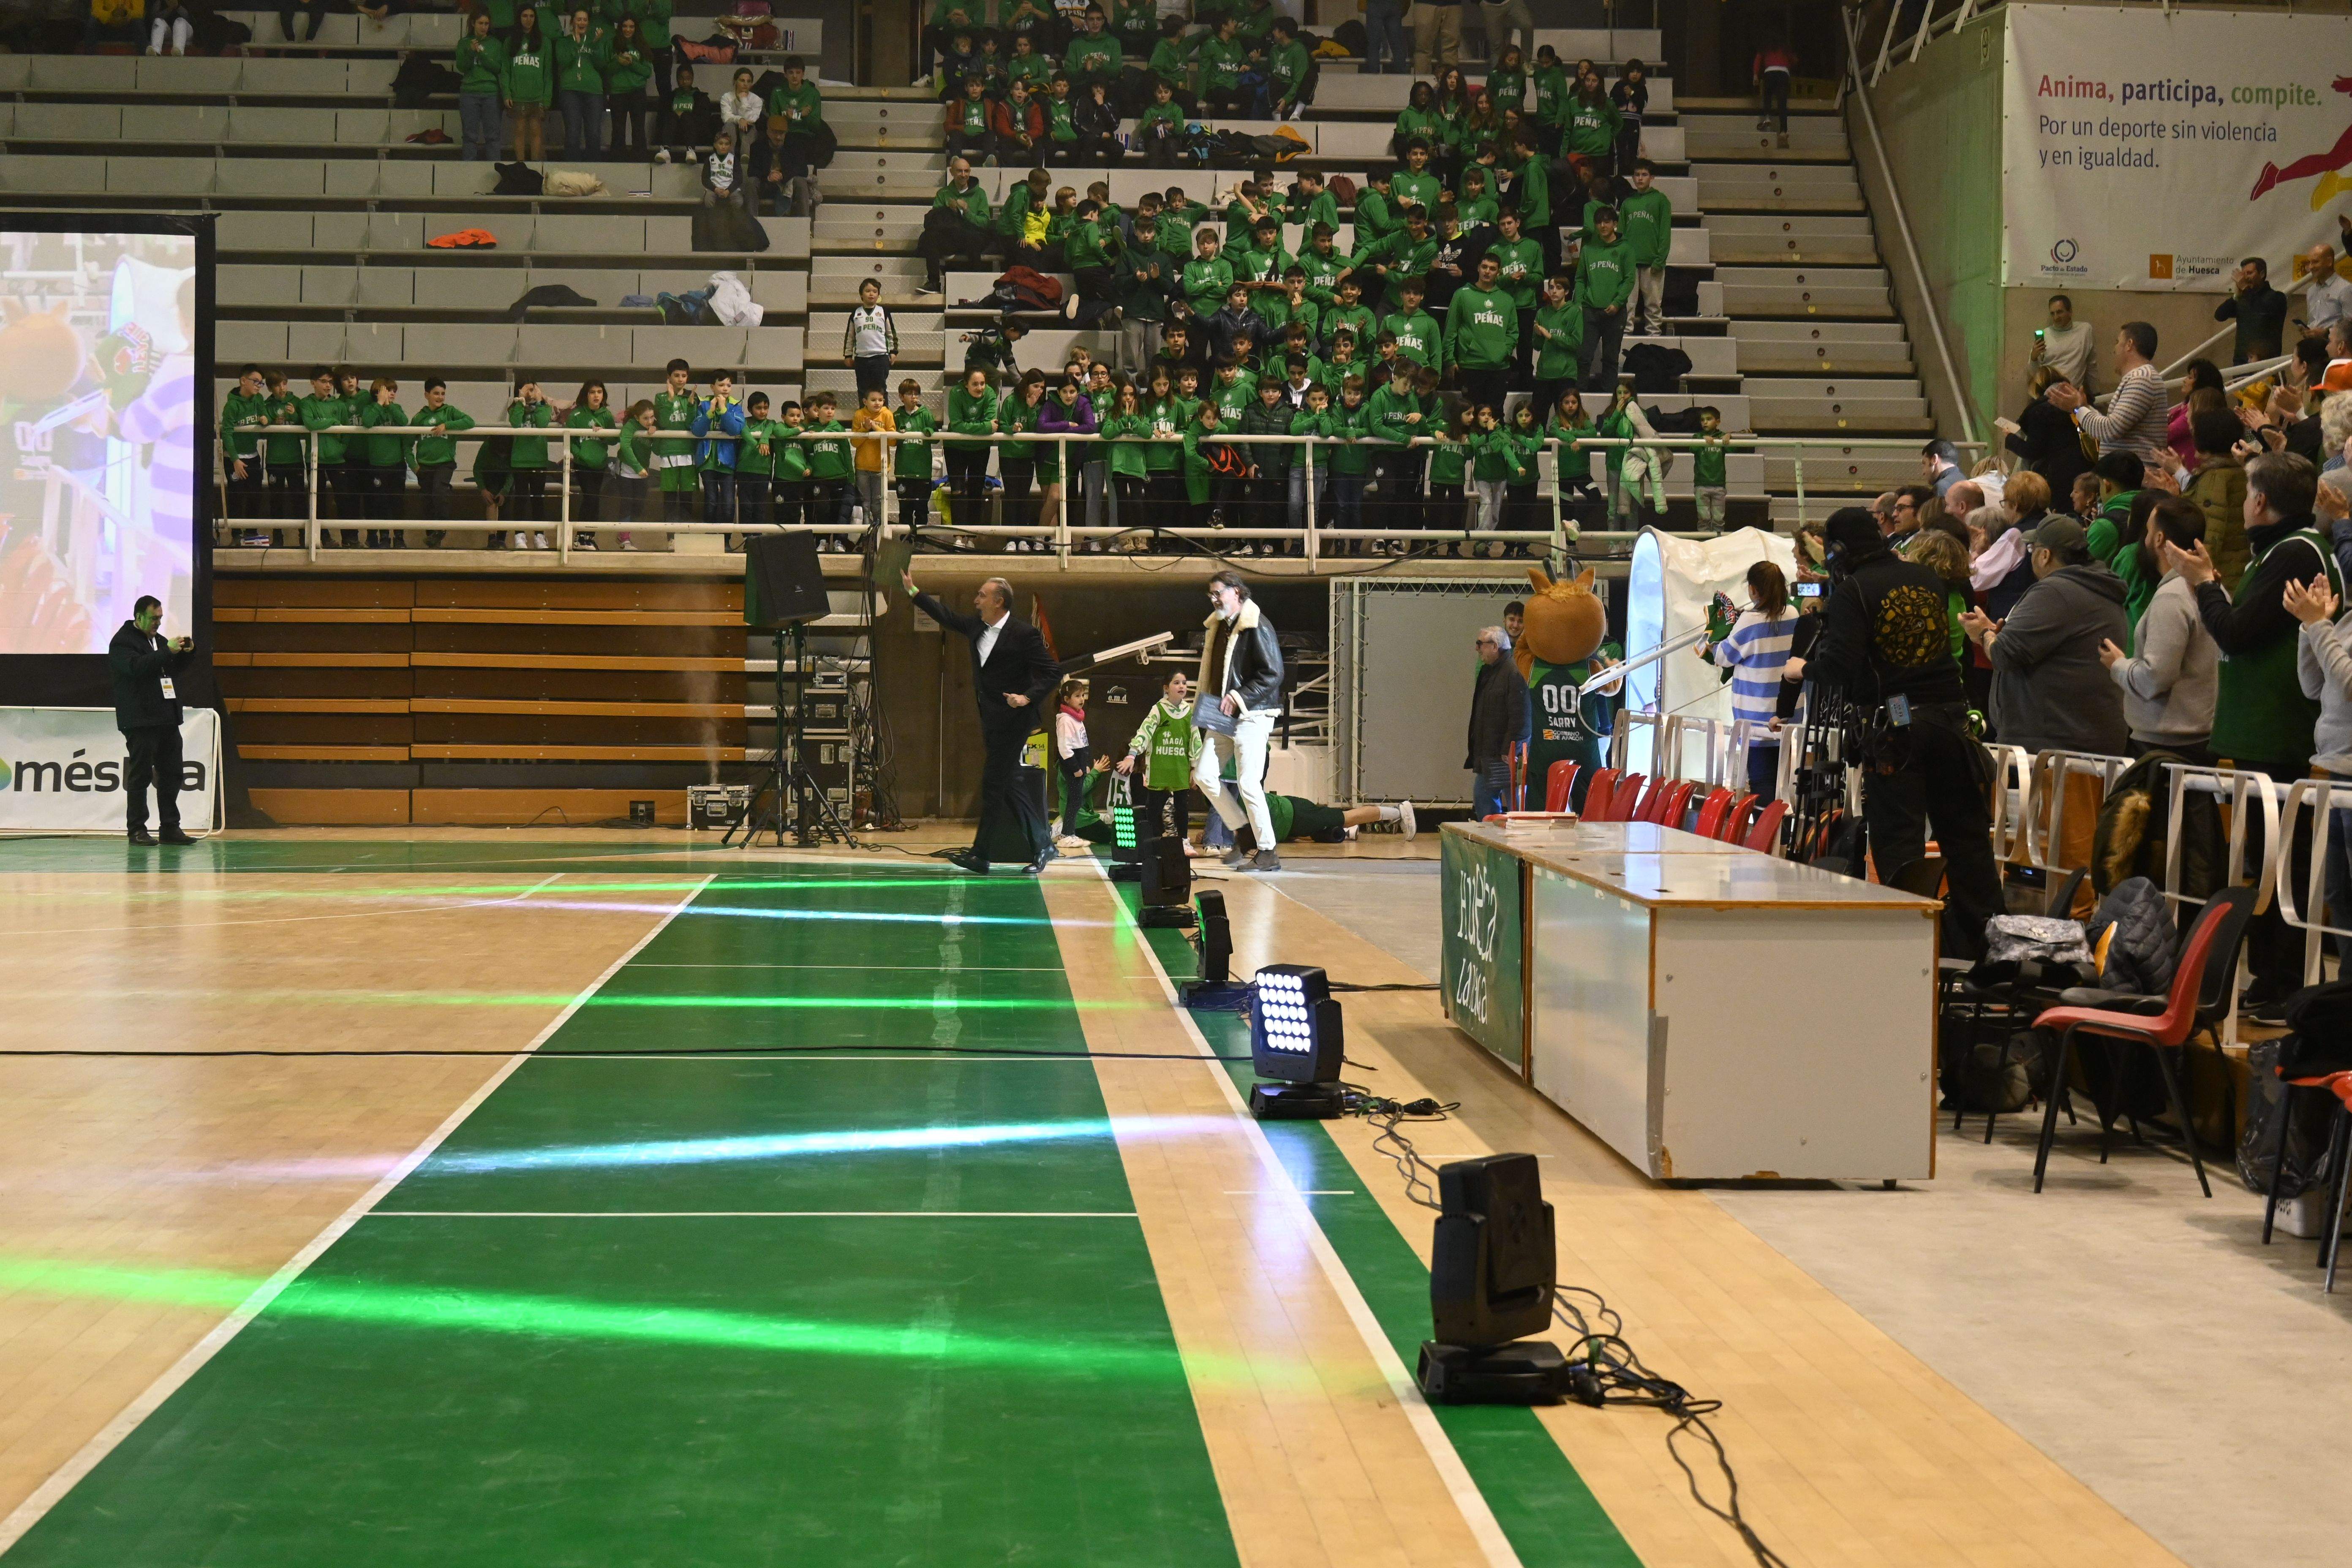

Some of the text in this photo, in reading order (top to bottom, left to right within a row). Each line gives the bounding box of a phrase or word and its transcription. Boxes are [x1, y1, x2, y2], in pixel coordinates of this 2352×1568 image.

[2038, 75, 2322, 109] Anima, participa, compite.
[2039, 115, 2277, 142] Por un deporte sin violencia
[2039, 146, 2159, 170] y en igualdad.
[1633, 211, 1654, 223] PEÑAS
[1598, 260, 1619, 272] PEÑAS
[2176, 254, 2234, 265] Ayuntamiento
[2176, 266, 2219, 275] de Huesca
[1474, 310, 1503, 327] PEÑAS
[863, 323, 882, 333] PEÑAS
[814, 441, 839, 453] PEÑAS
[1542, 684, 1576, 713] 00
[1548, 716, 1576, 728] SARRY
[14, 748, 206, 792] mésa
[1108, 778, 1128, 806] 15
